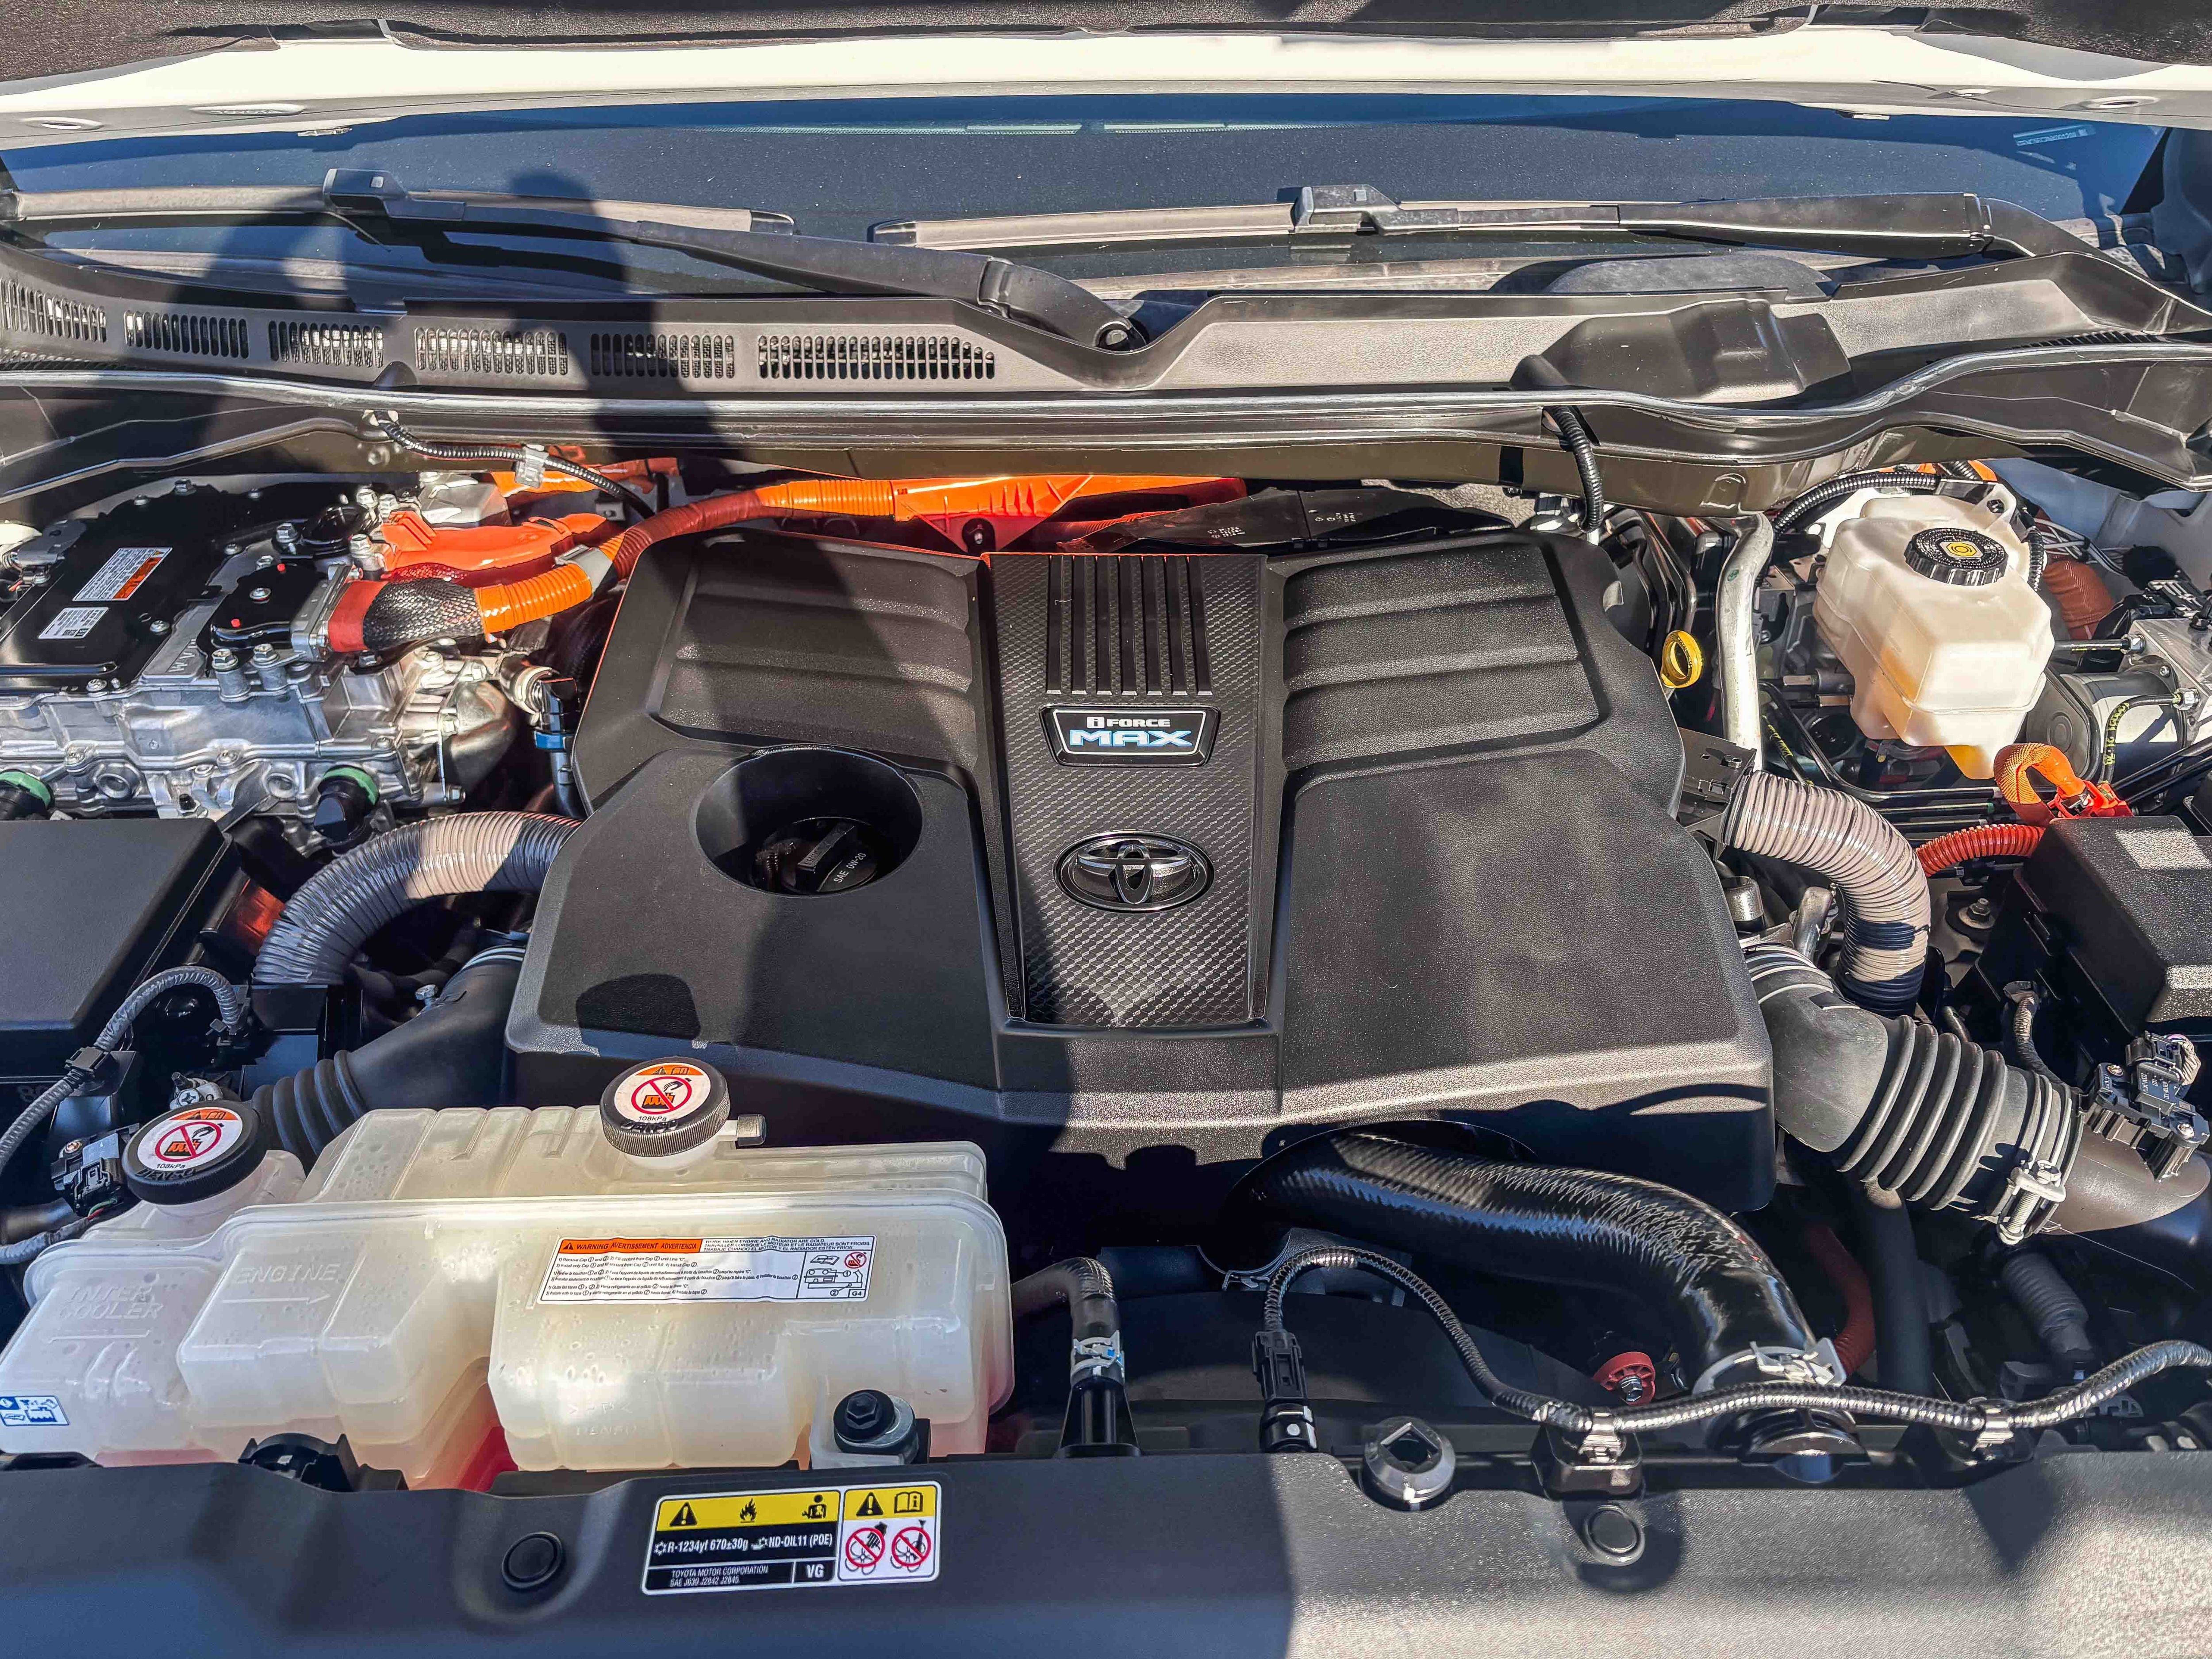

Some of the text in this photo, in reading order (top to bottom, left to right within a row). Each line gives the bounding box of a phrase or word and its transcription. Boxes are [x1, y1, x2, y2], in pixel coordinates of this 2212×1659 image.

[1107, 719, 1171, 727] FORCE
[1070, 729, 1193, 746] MAX
[833, 853, 866, 883] SAE 0W-20
[667, 1533, 832, 1553] R-1234yf 670±30g ND-OIL11 (POE)
[698, 1568, 722, 1576] MOTOR
[723, 1565, 768, 1575] CORPORATION
[806, 1564, 824, 1578] VG
